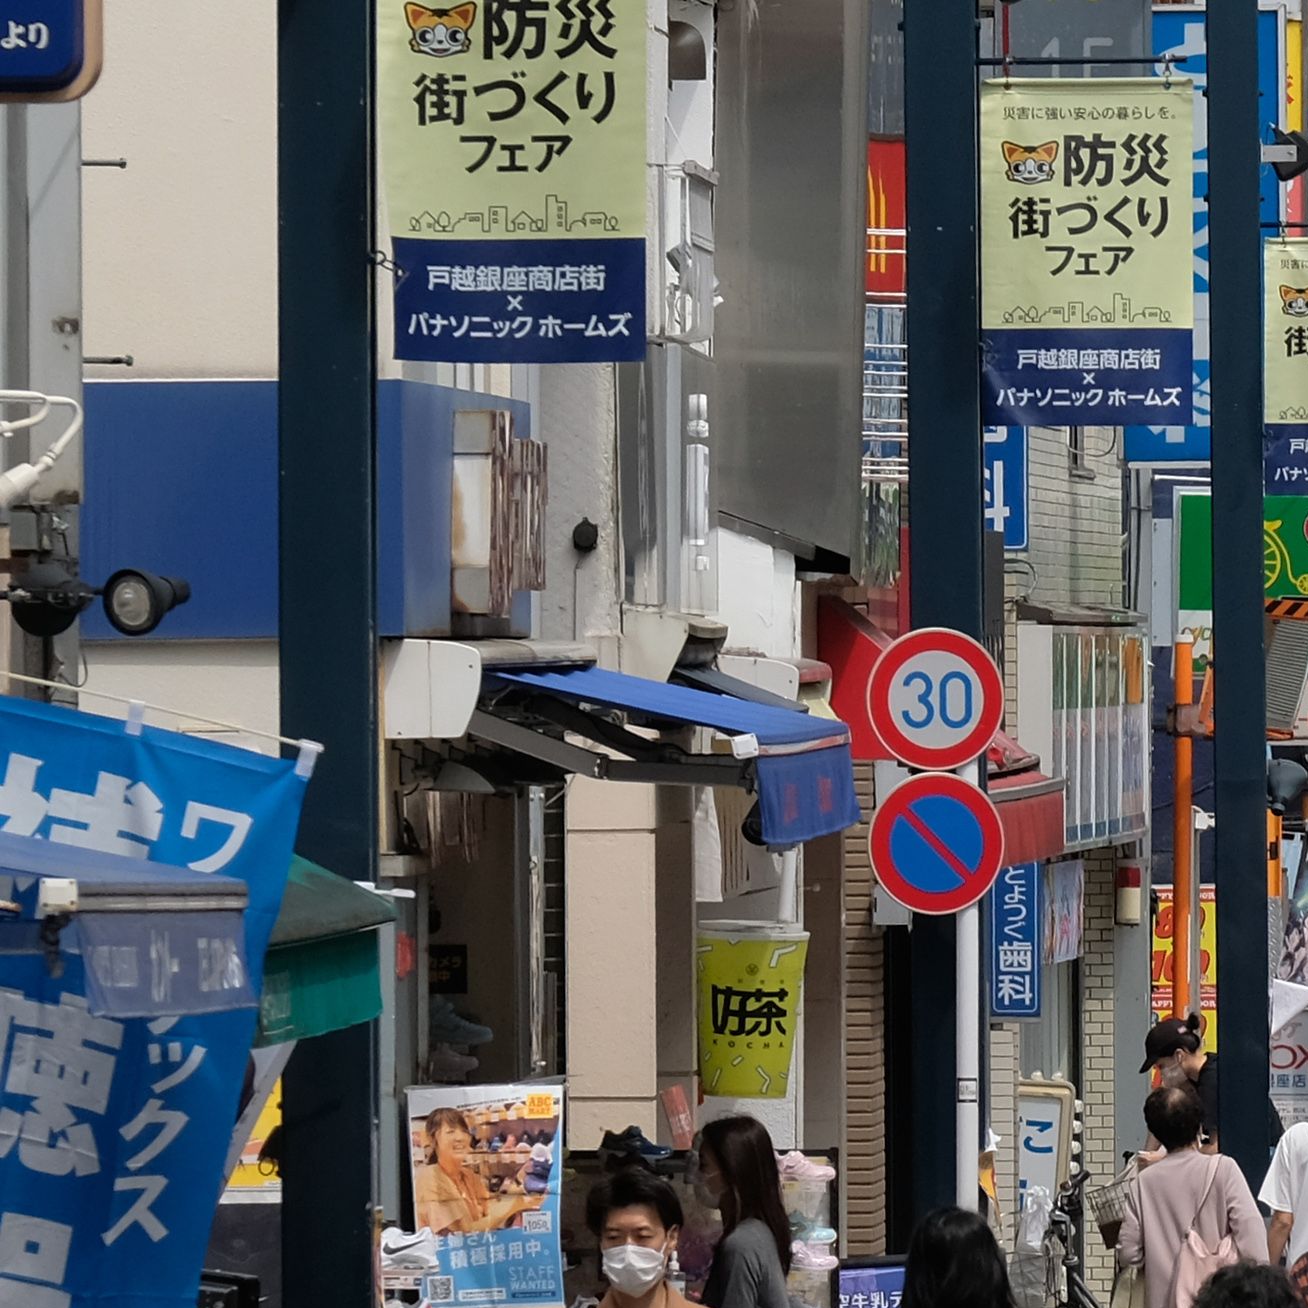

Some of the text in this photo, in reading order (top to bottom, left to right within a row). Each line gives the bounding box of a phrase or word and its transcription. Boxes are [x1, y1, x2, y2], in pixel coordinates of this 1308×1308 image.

[1, 21, 48, 48] より
[484, 0, 617, 59] 防災
[414, 71, 615, 125] 街づくり
[460, 135, 572, 173] フェア
[1064, 133, 1170, 187] 防災
[1009, 196, 1168, 239] 街づくり
[1045, 246, 1134, 276] フェア
[427, 265, 605, 291] 戸越銀座商店街
[409, 308, 631, 338] パナソニック ホームズ
[1018, 349, 1160, 374] 戸越銀座商店街
[997, 382, 1181, 406] パナソニック ホームズ
[900, 670, 974, 730] 30
[998, 866, 1034, 1006] とよつぐ歯科
[508, 1266, 556, 1281] STAFF
[509, 1280, 556, 1290] WANTED
